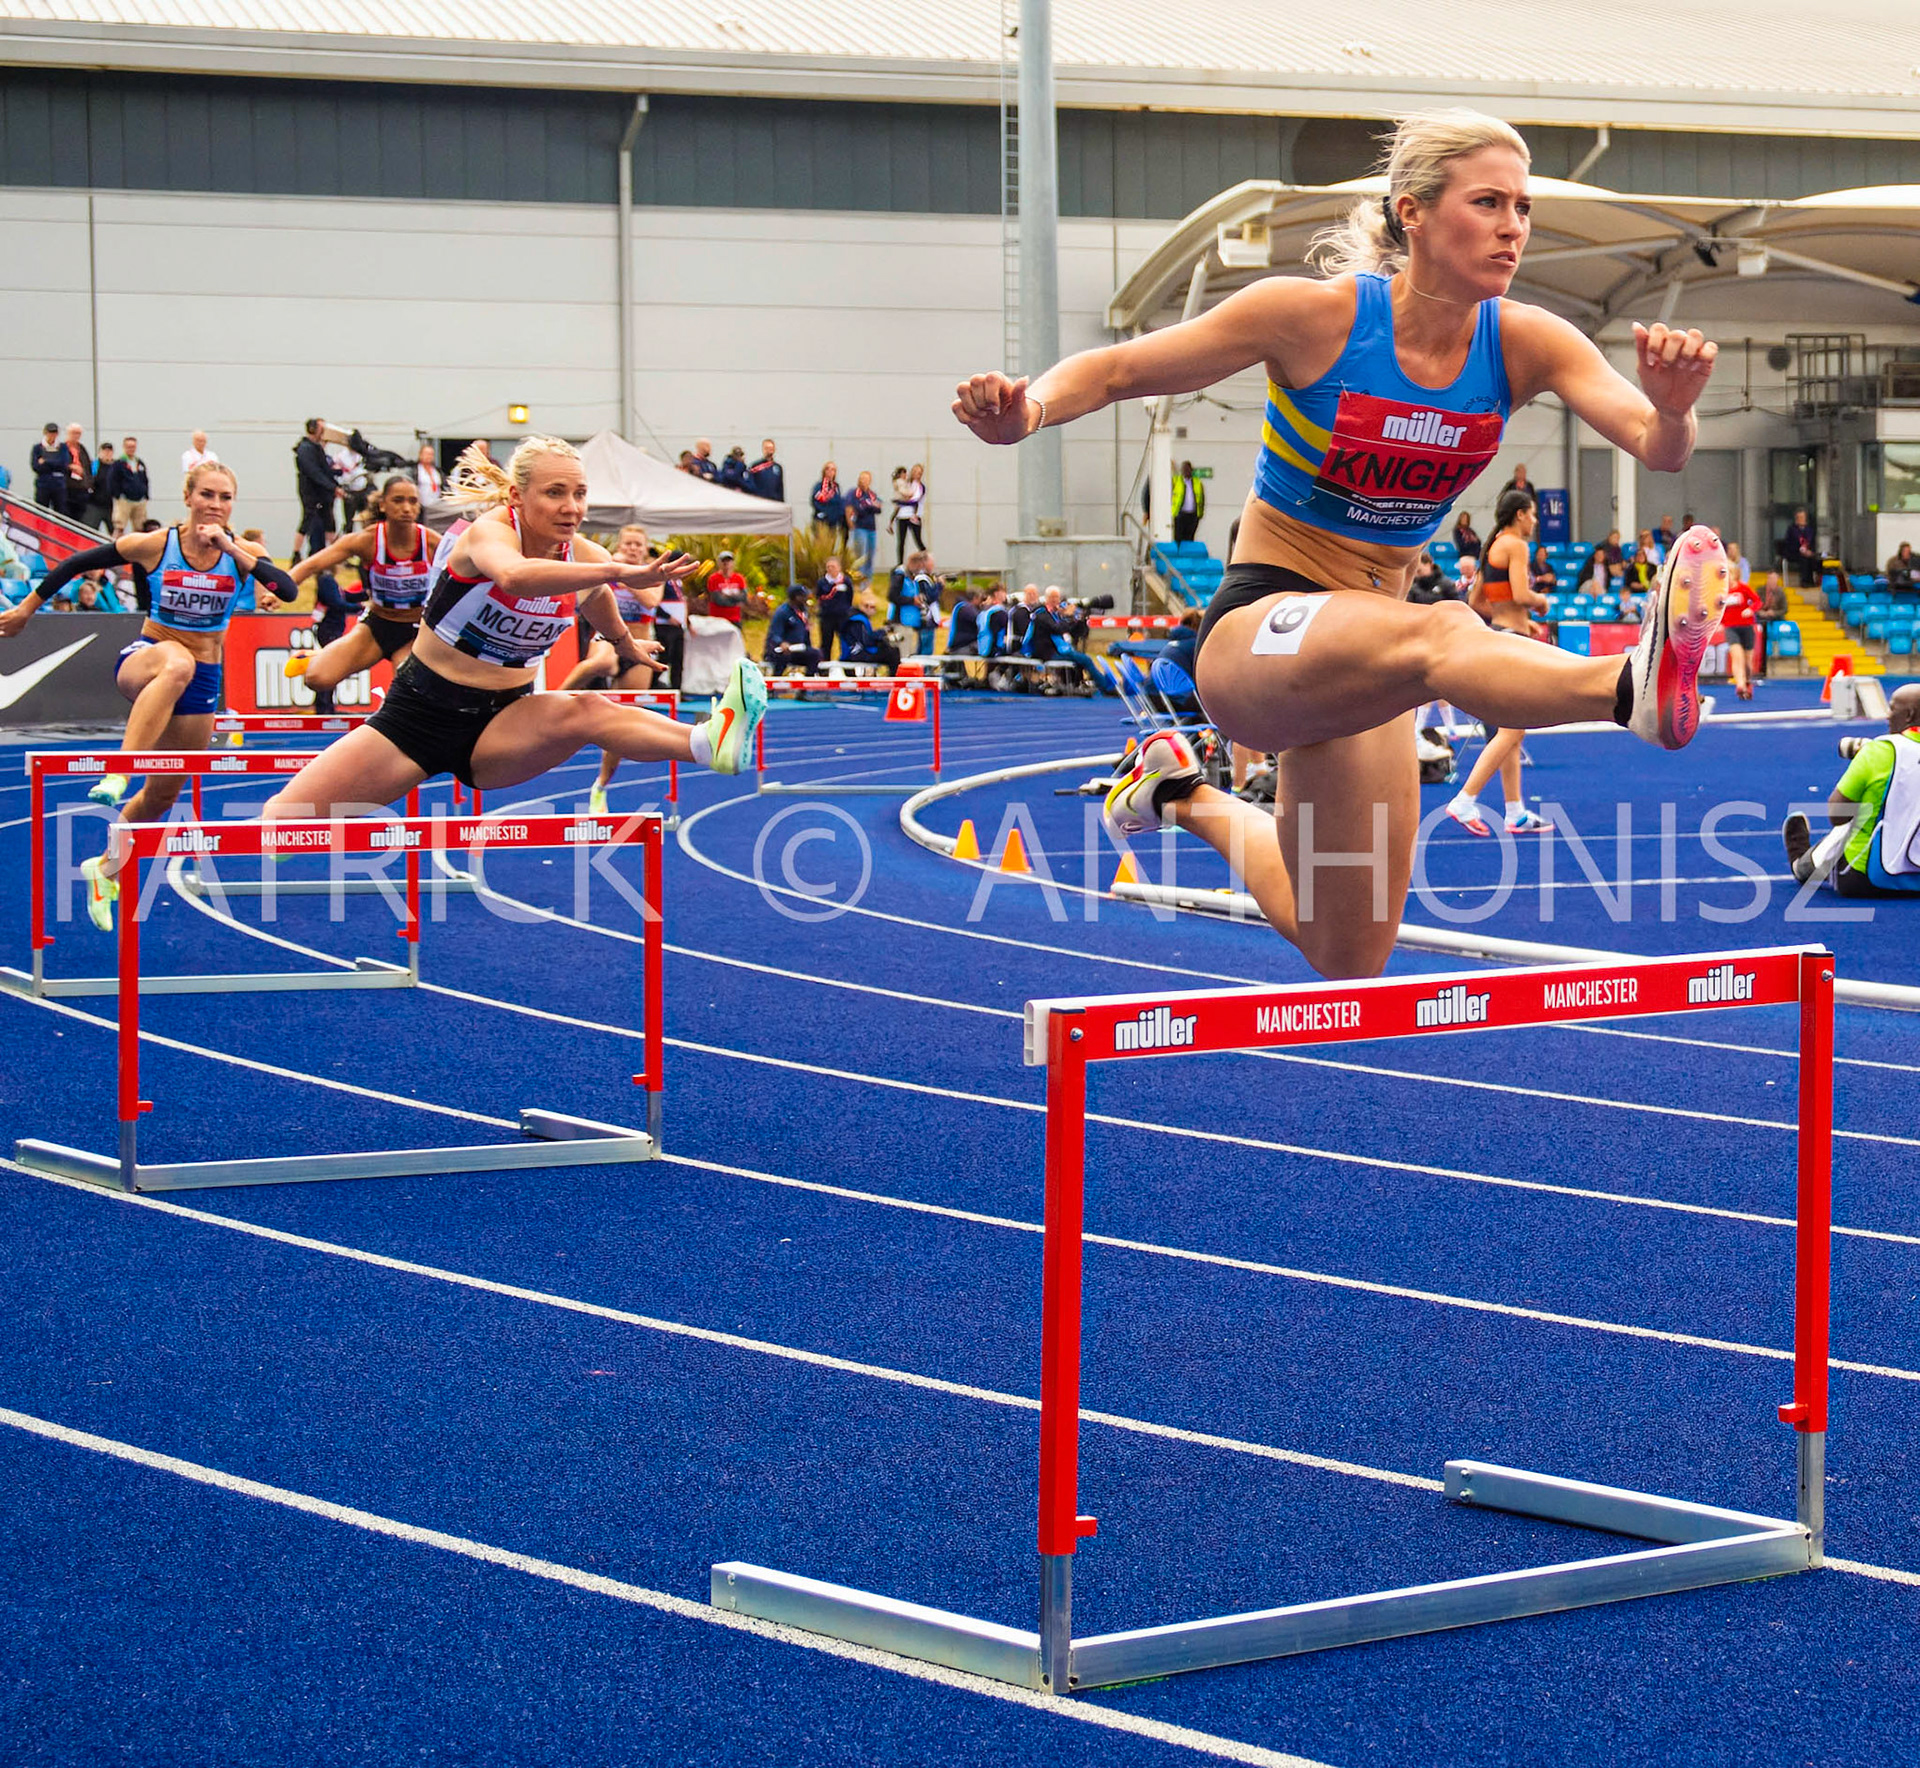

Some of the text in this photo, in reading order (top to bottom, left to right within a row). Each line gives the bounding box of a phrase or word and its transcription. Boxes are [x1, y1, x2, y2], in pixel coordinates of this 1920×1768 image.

[1382, 411, 1467, 448] müller
[1329, 448, 1489, 494] KNIGHT
[168, 590, 230, 611] TAPPIN
[514, 596, 562, 614] müller
[477, 604, 571, 641] MCLEAN
[897, 688, 914, 711] 6
[68, 757, 107, 772] müller
[133, 757, 185, 770] MANCHESTER
[210, 756, 248, 771] müller
[166, 821, 613, 852] müller MANCHESTER müller MANCHESTER müller
[1114, 964, 1756, 1051] müller MANCHESTER müller MANCHESTER müller
